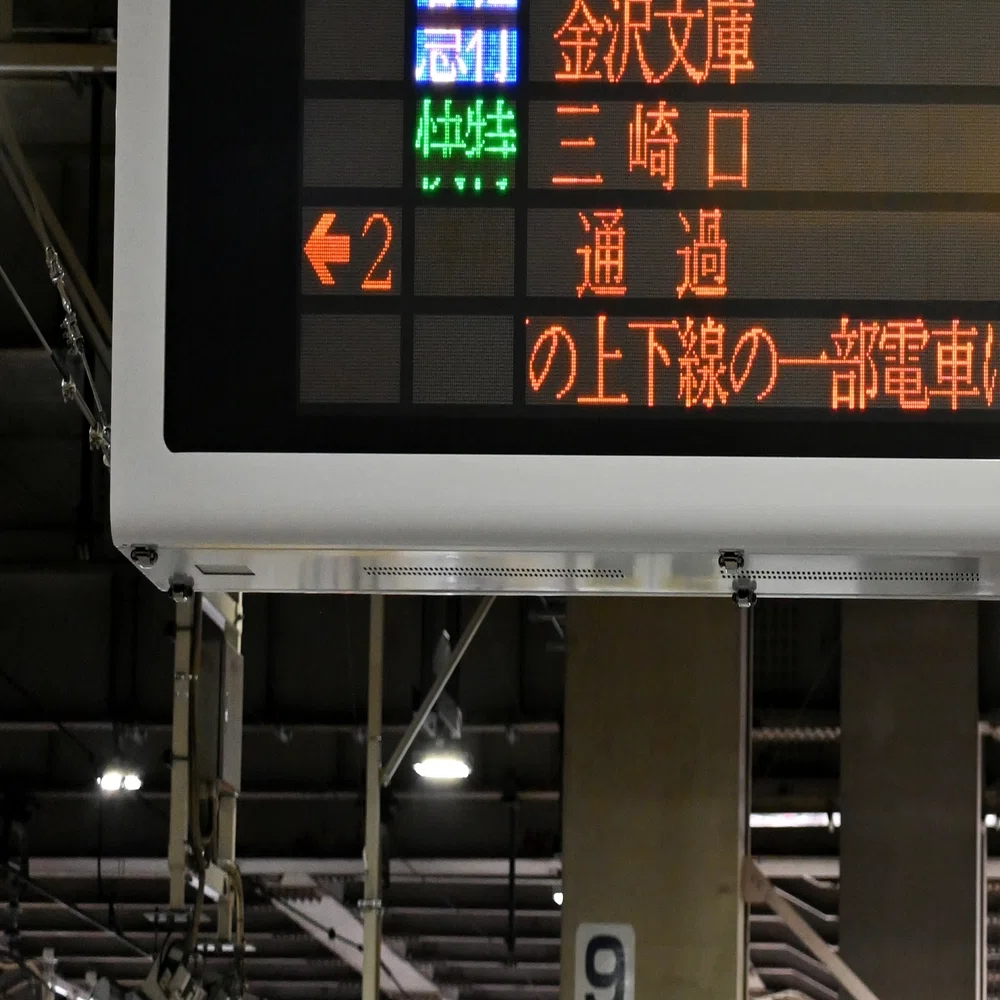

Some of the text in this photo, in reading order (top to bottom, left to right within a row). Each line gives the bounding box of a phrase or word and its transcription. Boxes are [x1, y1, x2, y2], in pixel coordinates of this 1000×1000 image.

[552, 101, 749, 190] 三崎口
[362, 208, 727, 298] 2 通過
